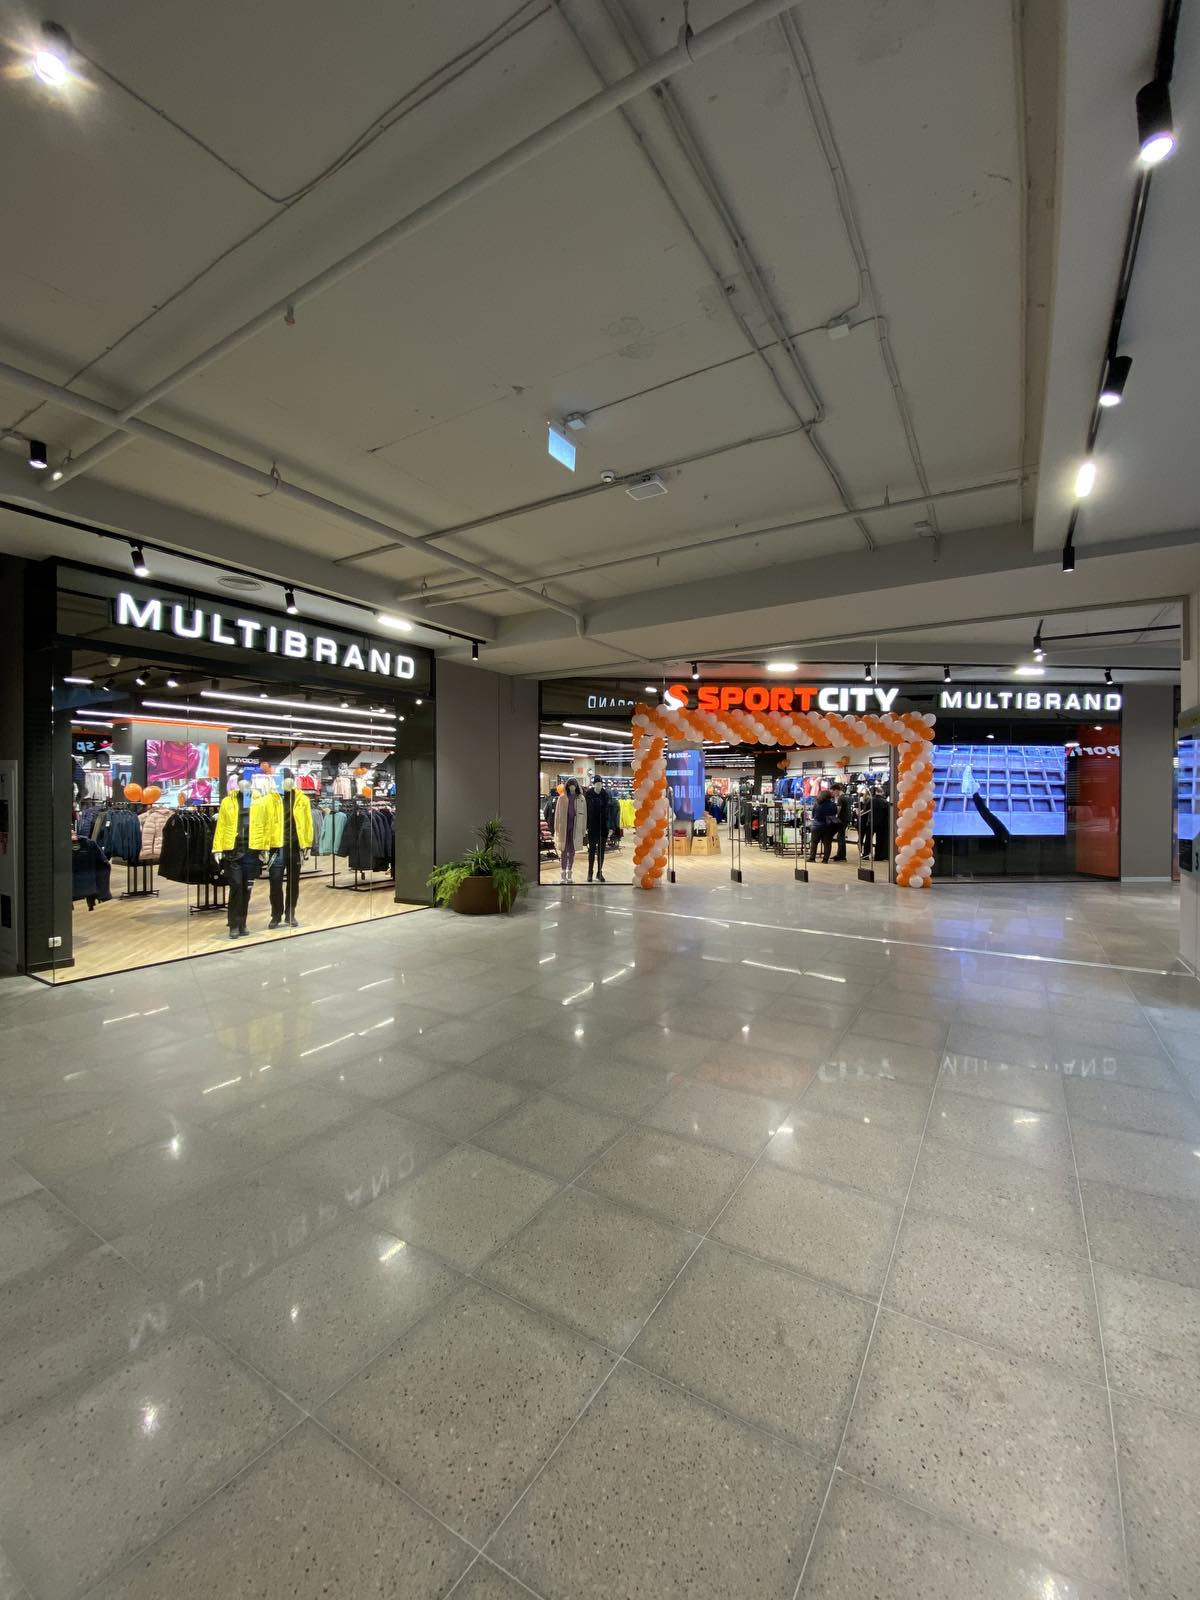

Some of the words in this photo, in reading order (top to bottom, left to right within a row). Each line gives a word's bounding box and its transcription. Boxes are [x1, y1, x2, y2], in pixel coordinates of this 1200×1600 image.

[117, 592, 416, 680] MULTIBRAND
[698, 687, 899, 712] SPORTCITY
[940, 691, 1122, 711] MULTIBRAND
